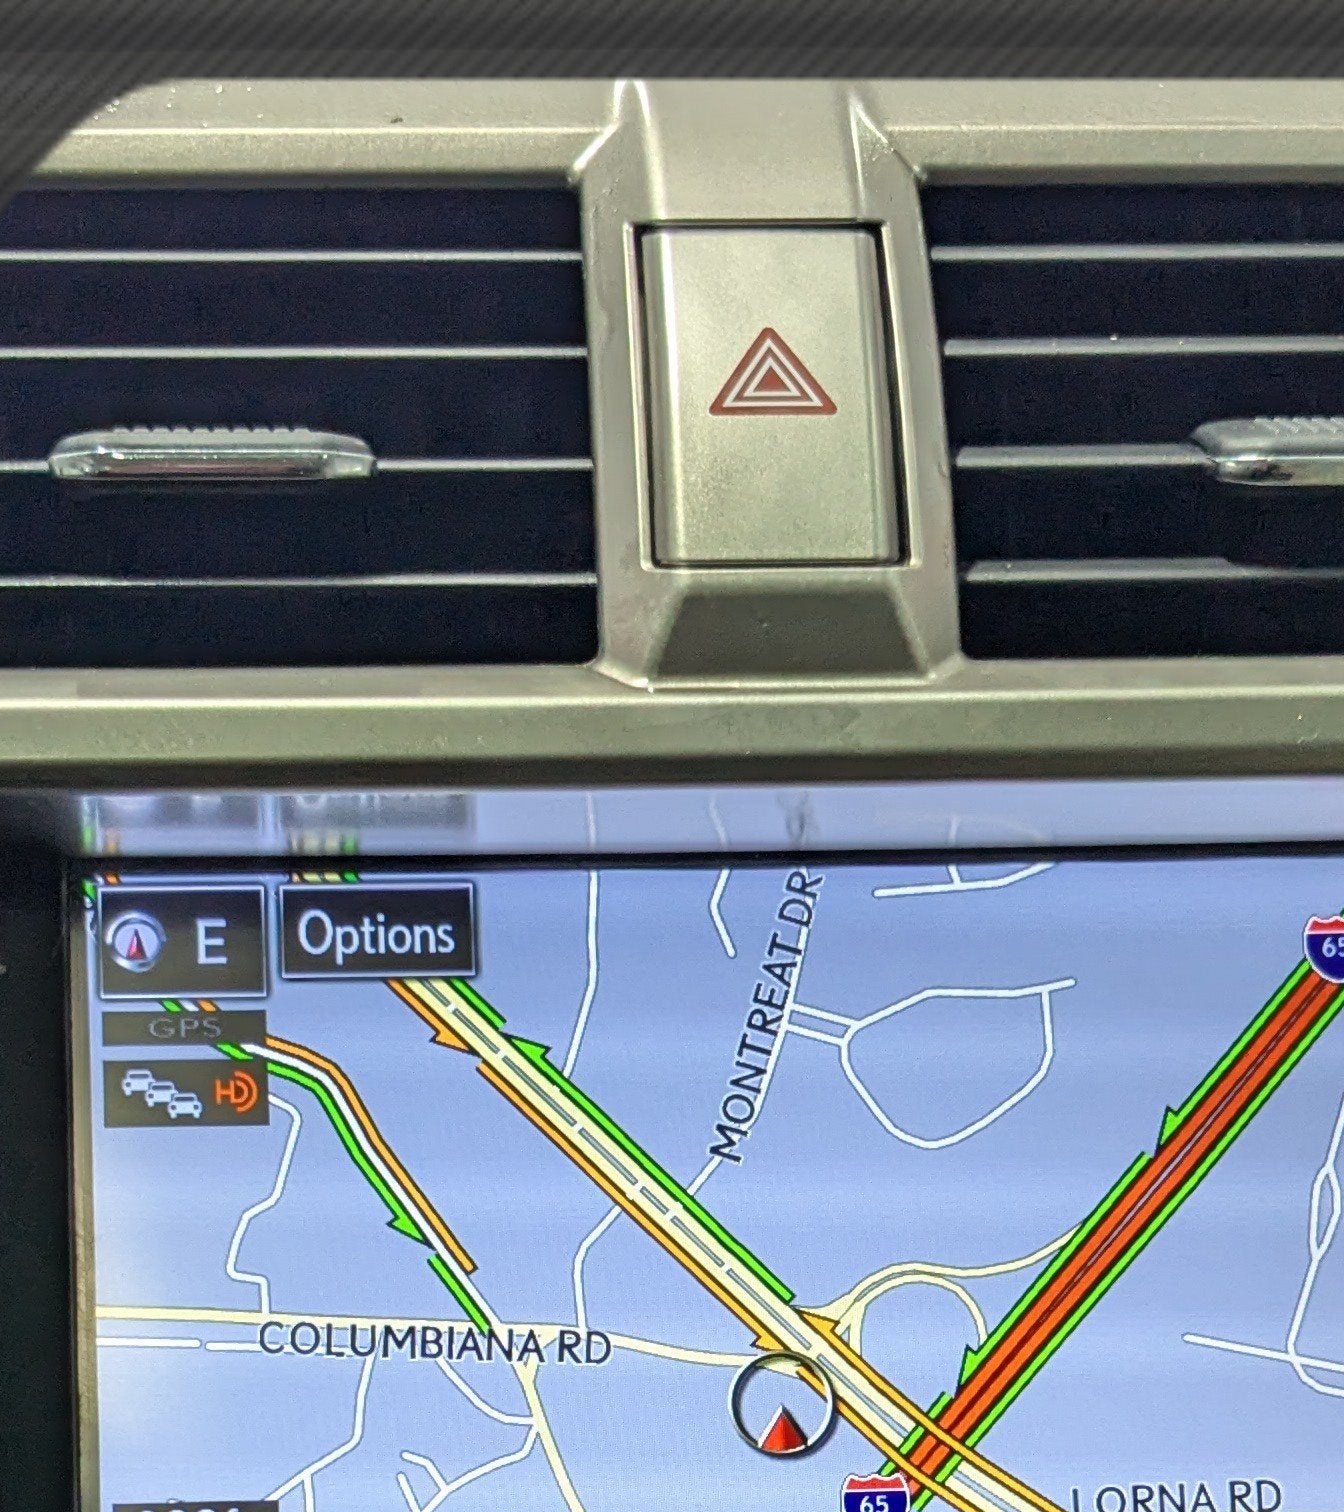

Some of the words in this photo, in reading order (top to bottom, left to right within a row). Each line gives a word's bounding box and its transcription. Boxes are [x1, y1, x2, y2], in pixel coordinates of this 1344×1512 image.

[196, 917, 229, 965] E
[297, 907, 456, 967] Options
[147, 1017, 223, 1040] GPS
[709, 931, 805, 1164] MONTREAT
[777, 868, 824, 929] DR
[258, 1320, 546, 1365] COLUMBIANA
[558, 1328, 612, 1367] RD
